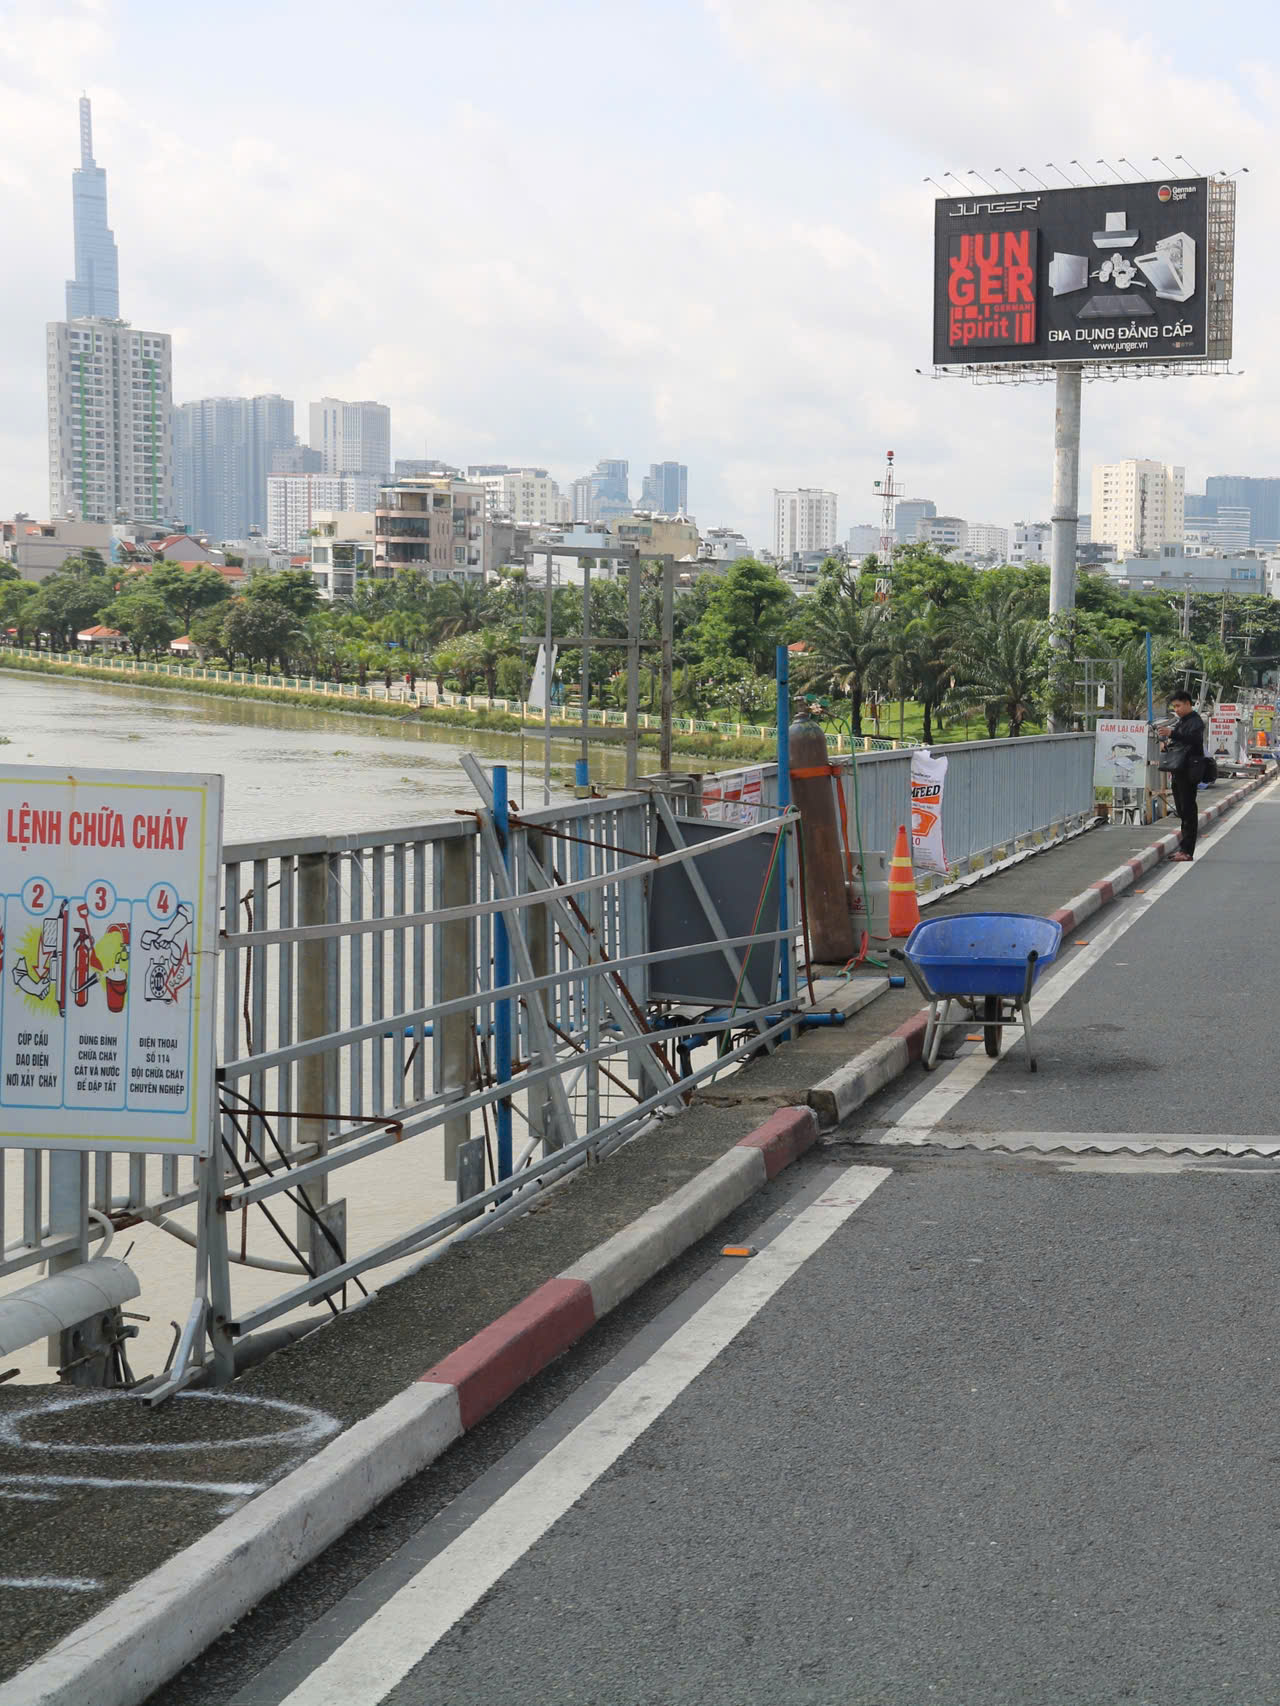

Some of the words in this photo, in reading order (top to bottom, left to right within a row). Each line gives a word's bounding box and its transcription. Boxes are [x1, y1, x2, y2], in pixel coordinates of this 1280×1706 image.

[1172, 192, 1187, 201] Spirit
[949, 199, 1038, 216] JUNGER
[949, 230, 1030, 269] JUN
[948, 265, 1035, 306] GER
[950, 314, 1009, 346] spirit
[1048, 330, 1072, 342] GIA
[1075, 327, 1115, 344] DỤNG
[1118, 320, 1158, 339] ĐẲNG
[1162, 318, 1193, 337] CẤP
[1092, 341, 1148, 352] www.junger.vn
[7, 802, 62, 851] LỆNH
[68, 806, 125, 848] CHỮA
[132, 808, 188, 850] CHÁY
[31, 884, 44, 908] 2
[95, 887, 107, 911] 3
[156, 889, 169, 913] 4
[139, 1035, 156, 1049] ĐIỆN
[157, 1038, 178, 1051] THOẠI
[16, 1053, 30, 1066] DAO
[32, 1051, 49, 1069] ĐIỆN
[158, 1054, 170, 1064] 114
[38, 1072, 58, 1088] CHÁY
[129, 1082, 157, 1093] CHUYÊN
[159, 1083, 185, 1096] NGHIỆP
